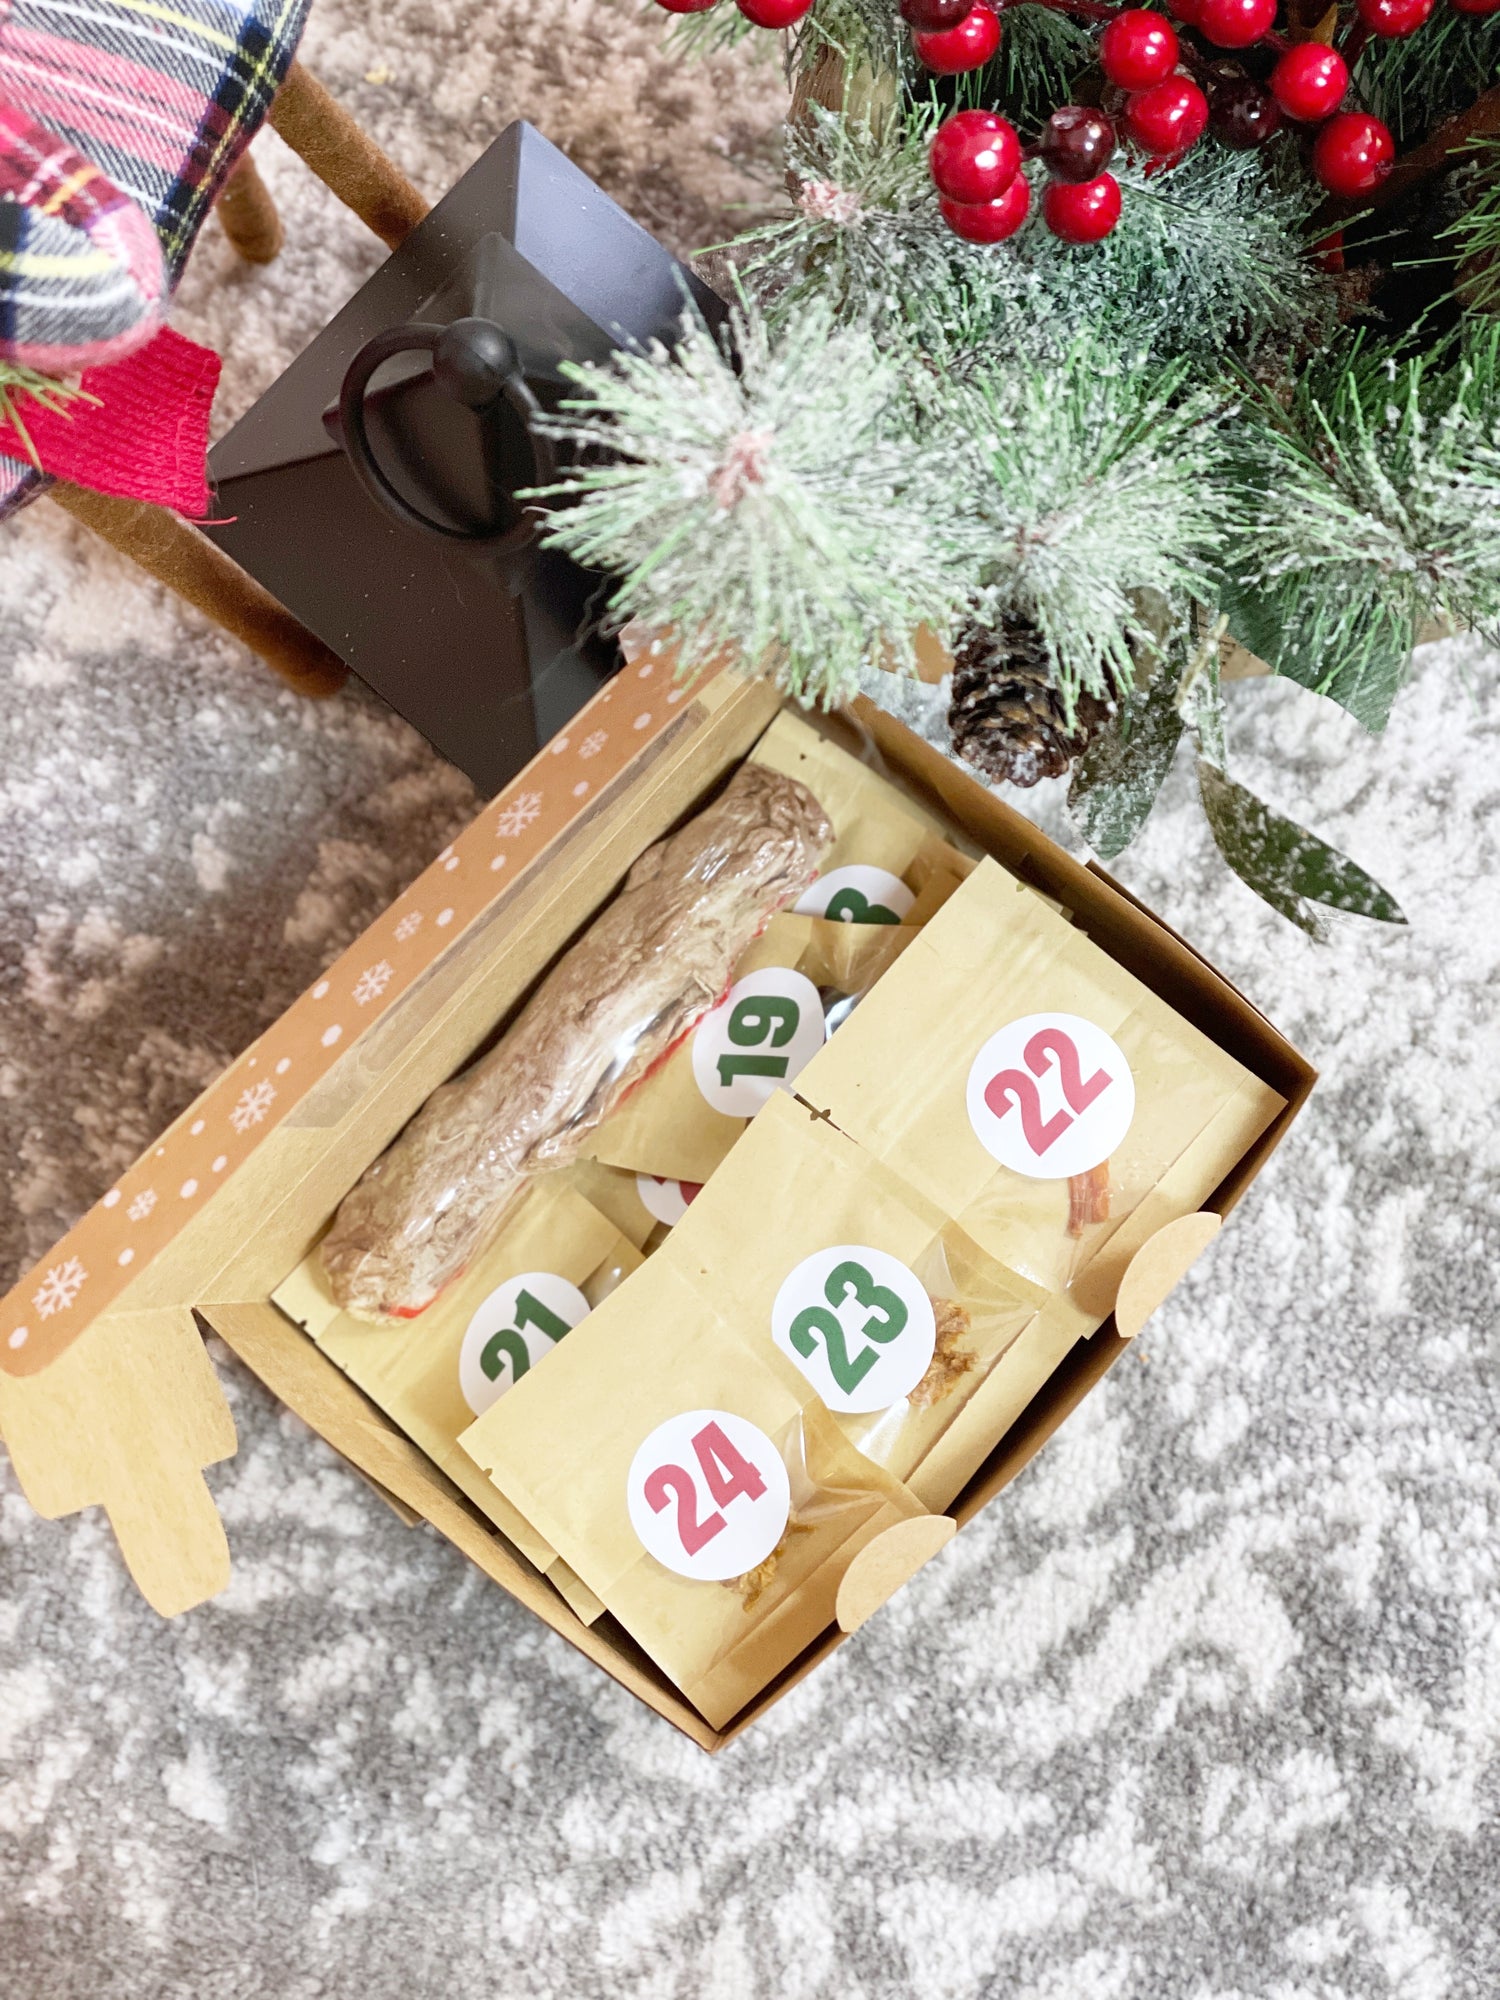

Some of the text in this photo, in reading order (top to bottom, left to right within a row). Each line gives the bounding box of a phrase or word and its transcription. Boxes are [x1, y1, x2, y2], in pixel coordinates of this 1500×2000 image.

[717, 995, 800, 1087] 19
[984, 1027, 1113, 1157] 22
[480, 1288, 573, 1384] 21
[789, 1261, 909, 1396] 23
[643, 1420, 768, 1558] 24
